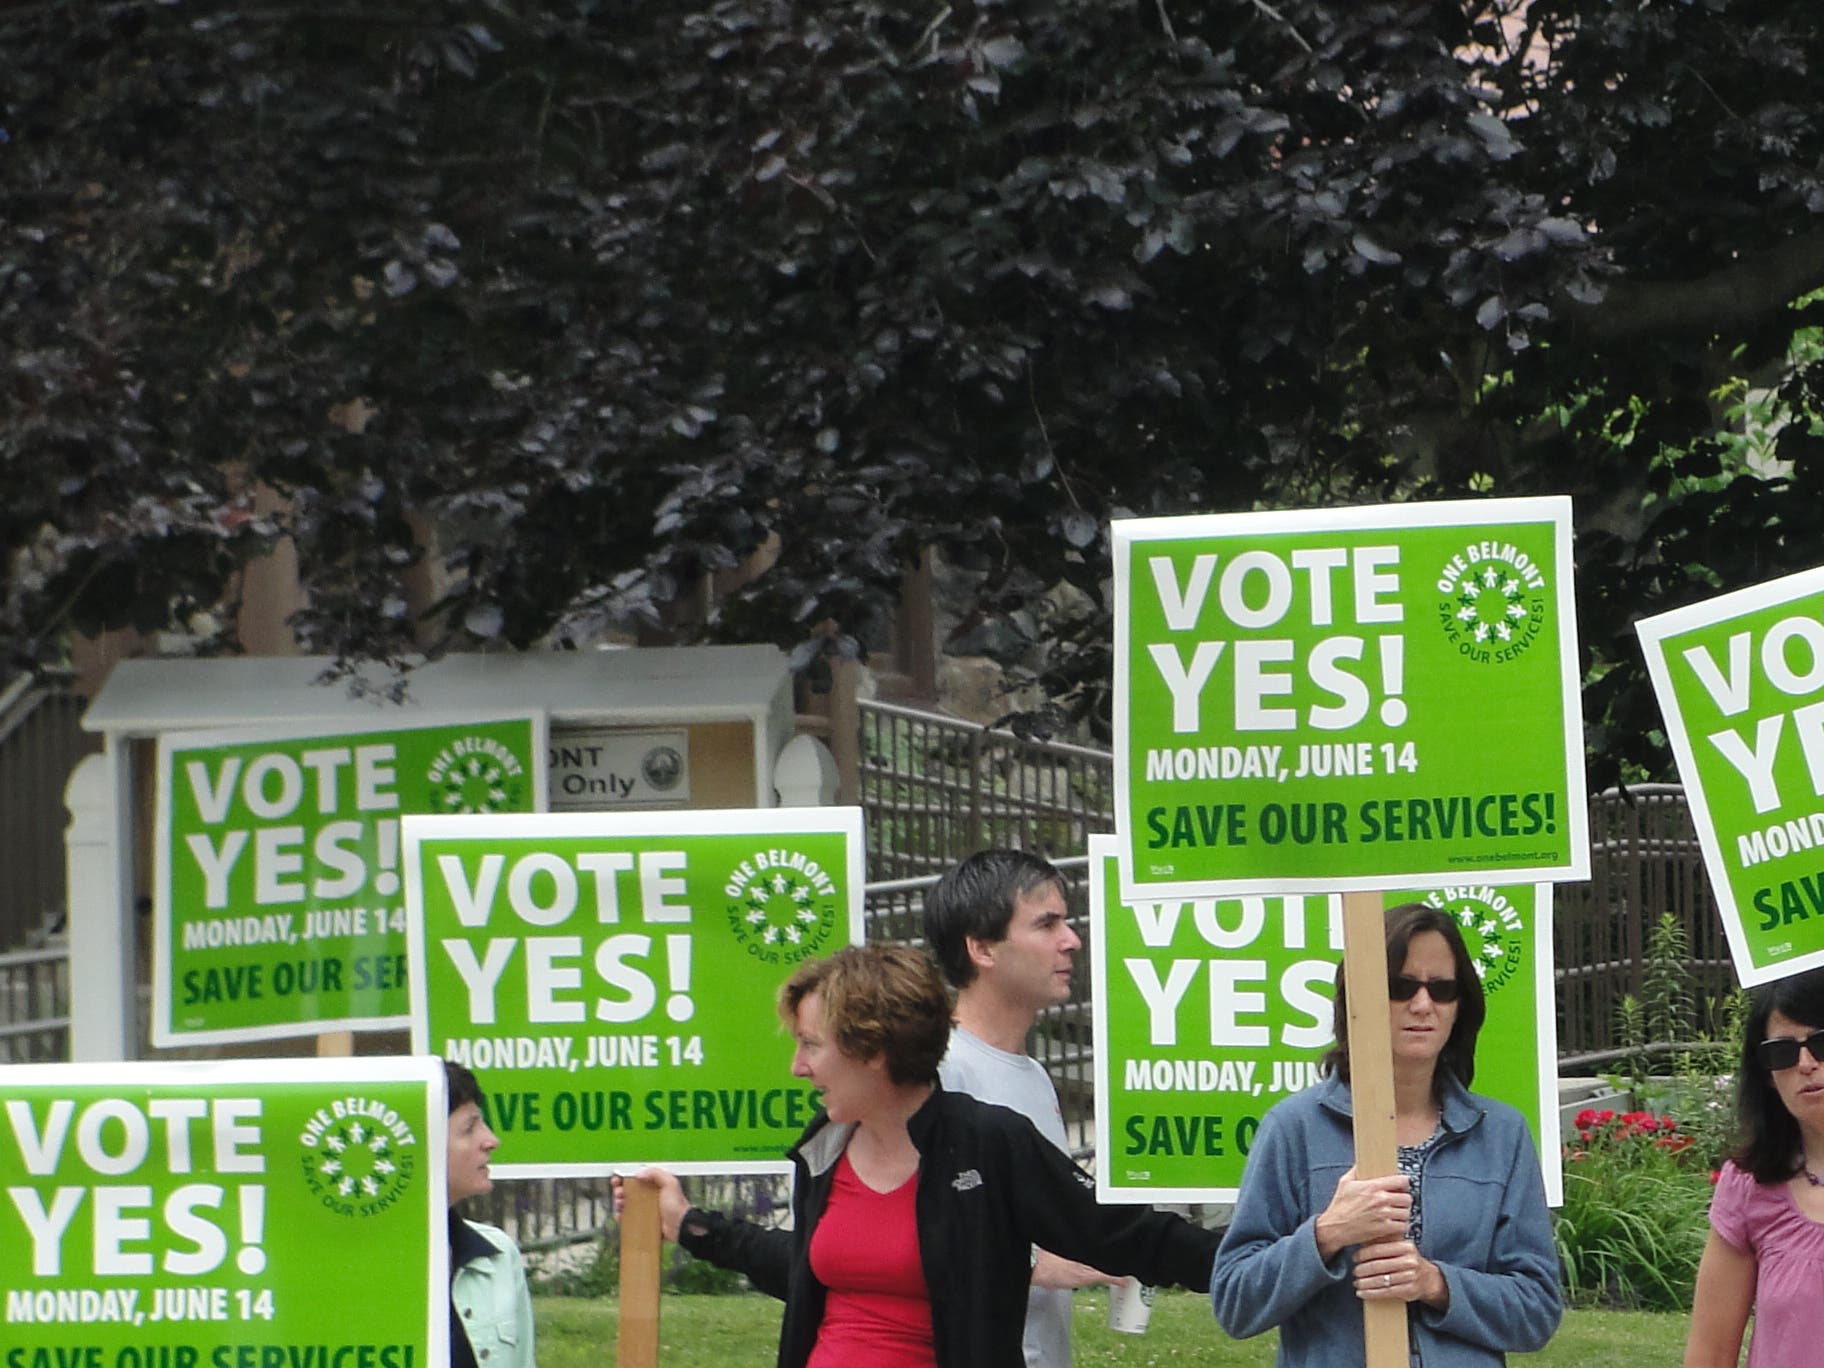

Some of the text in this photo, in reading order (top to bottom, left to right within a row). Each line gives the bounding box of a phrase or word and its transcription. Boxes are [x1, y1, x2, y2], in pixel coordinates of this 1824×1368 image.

[1149, 545, 1404, 631] VOTE
[1437, 541, 1545, 593] ONE BELMONT
[1440, 598, 1544, 664] SAVE OUR SERVICES!
[1147, 634, 1408, 733] YES!
[186, 744, 400, 823] VOTE
[562, 773, 635, 798] Only
[1146, 742, 1418, 783] MONDAY, JUNE 14
[1147, 792, 1556, 849] SAVE OUR SERVICES!
[185, 819, 400, 908] YES!
[724, 849, 836, 897] ONE BELMONT
[437, 851, 692, 927] VOTE
[1444, 886, 1523, 931] BELMONT
[184, 907, 407, 949] MONDAY, JUNE 14
[184, 964, 263, 1005] SAVE
[272, 958, 342, 995] OUR
[441, 934, 694, 1024] YES!
[445, 1036, 704, 1073] MONDAY, JUNE 14
[1125, 1059, 1263, 1097] MONDAY,
[6, 1098, 266, 1175] VOTE
[299, 1097, 416, 1147] ONE BELMONT
[552, 1091, 633, 1132] OUR
[1125, 1114, 1224, 1157] SAVE
[6, 1184, 267, 1276] YES!
[6, 1288, 274, 1327] MONDAY, JUNE 14
